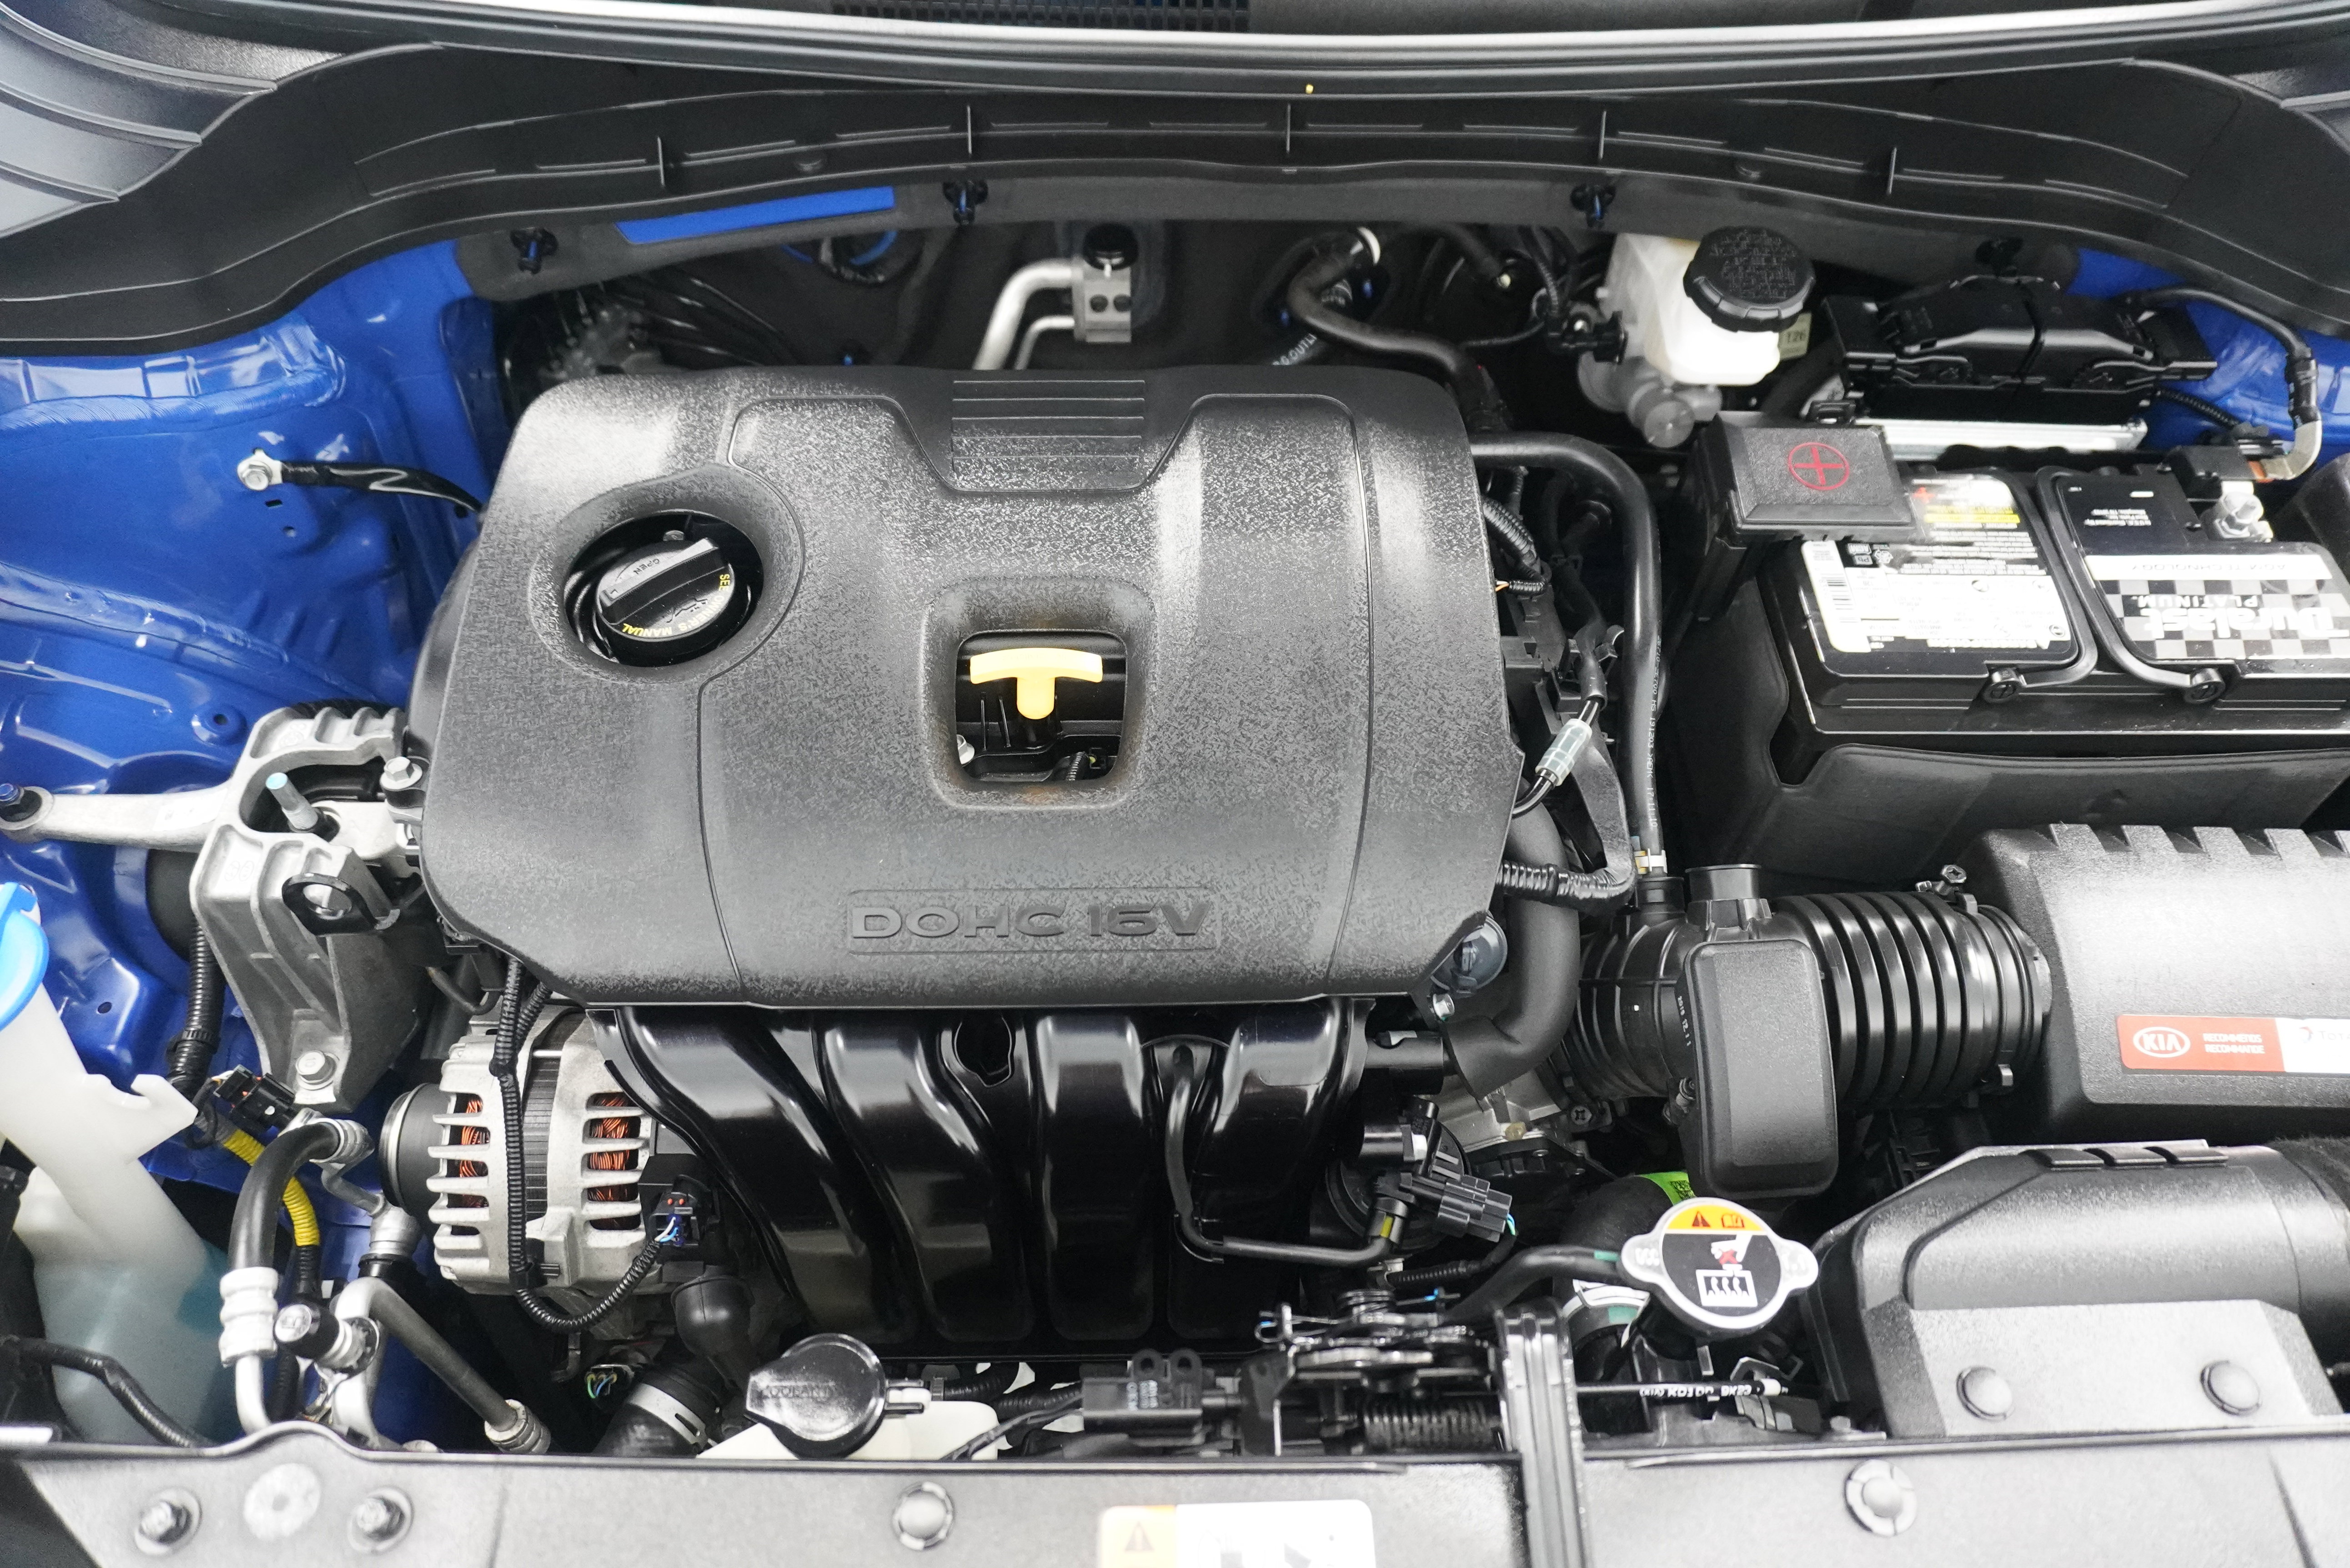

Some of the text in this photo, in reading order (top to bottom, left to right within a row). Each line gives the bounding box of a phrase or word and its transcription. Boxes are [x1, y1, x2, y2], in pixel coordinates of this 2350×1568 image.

[633, 558, 660, 574] OPEN
[622, 574, 730, 637] SEE OWNER'S MANUAL
[2140, 607, 2350, 638] Duralast
[1651, 700, 1657, 711] HS
[1647, 717, 1656, 748] 191203
[1647, 787, 1658, 827] 17:11:10
[852, 905, 1208, 938] DOHC 16V
[2141, 1033, 2182, 1051] KIA
[2202, 1032, 2262, 1044] RECOMMENDS
[2204, 1043, 2265, 1055] RECOMMANDE
